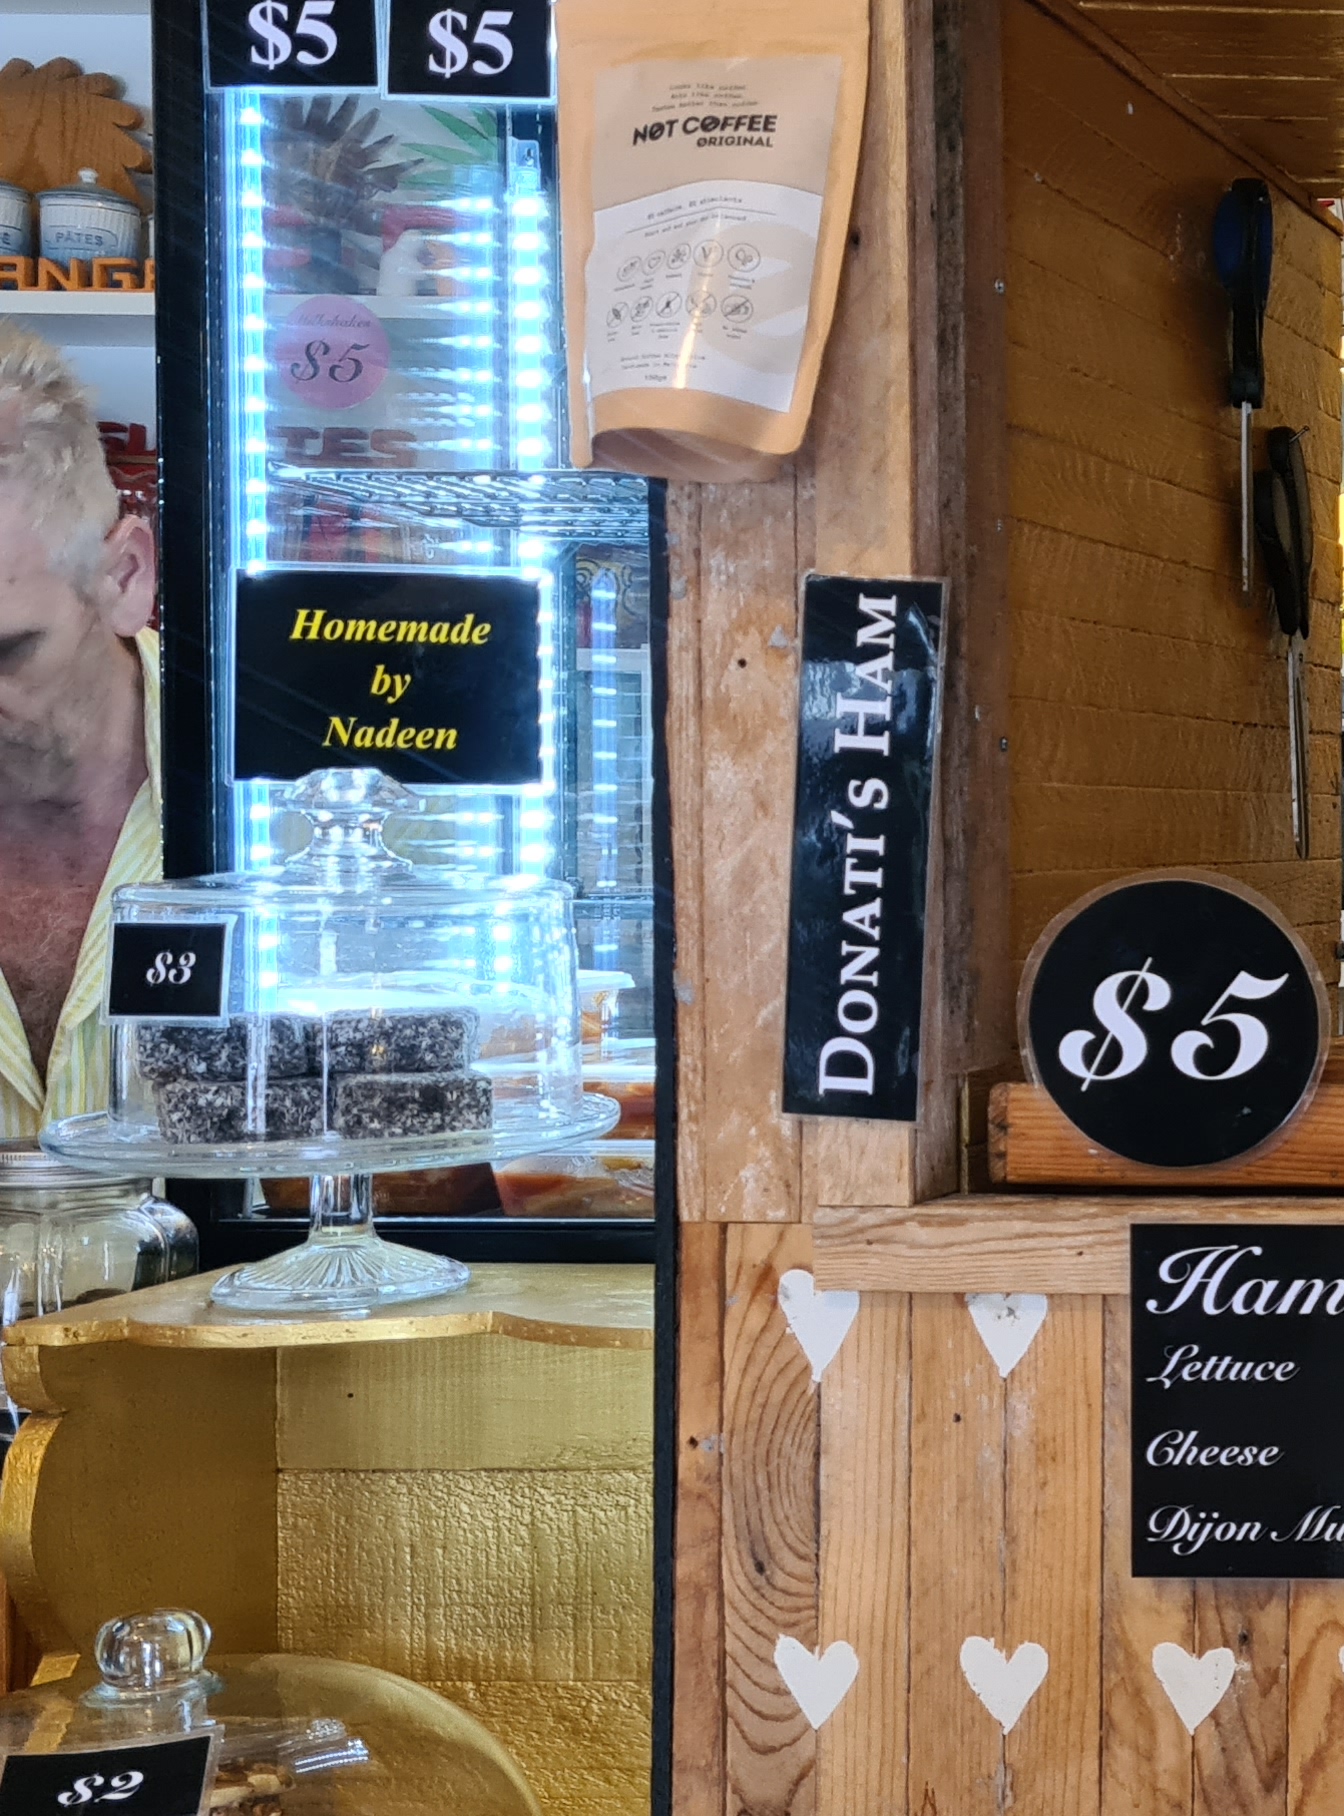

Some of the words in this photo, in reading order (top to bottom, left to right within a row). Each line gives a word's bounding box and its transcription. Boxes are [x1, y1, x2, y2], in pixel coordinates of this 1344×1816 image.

[248, 0, 338, 70] $5
[428, 8, 514, 79] $5
[290, 338, 371, 384] $5
[289, 608, 493, 647] Homemade
[370, 664, 411, 704] by
[834, 592, 898, 758] HAM
[322, 716, 458, 750] Nadeen
[145, 948, 196, 986] $3
[1058, 957, 1290, 1092] $5
[1146, 1344, 1299, 1389] Lettuce
[1146, 1429, 1285, 1467] Cheese
[1146, 1504, 1268, 1556] Dijon
[56, 1769, 145, 1808] $2
